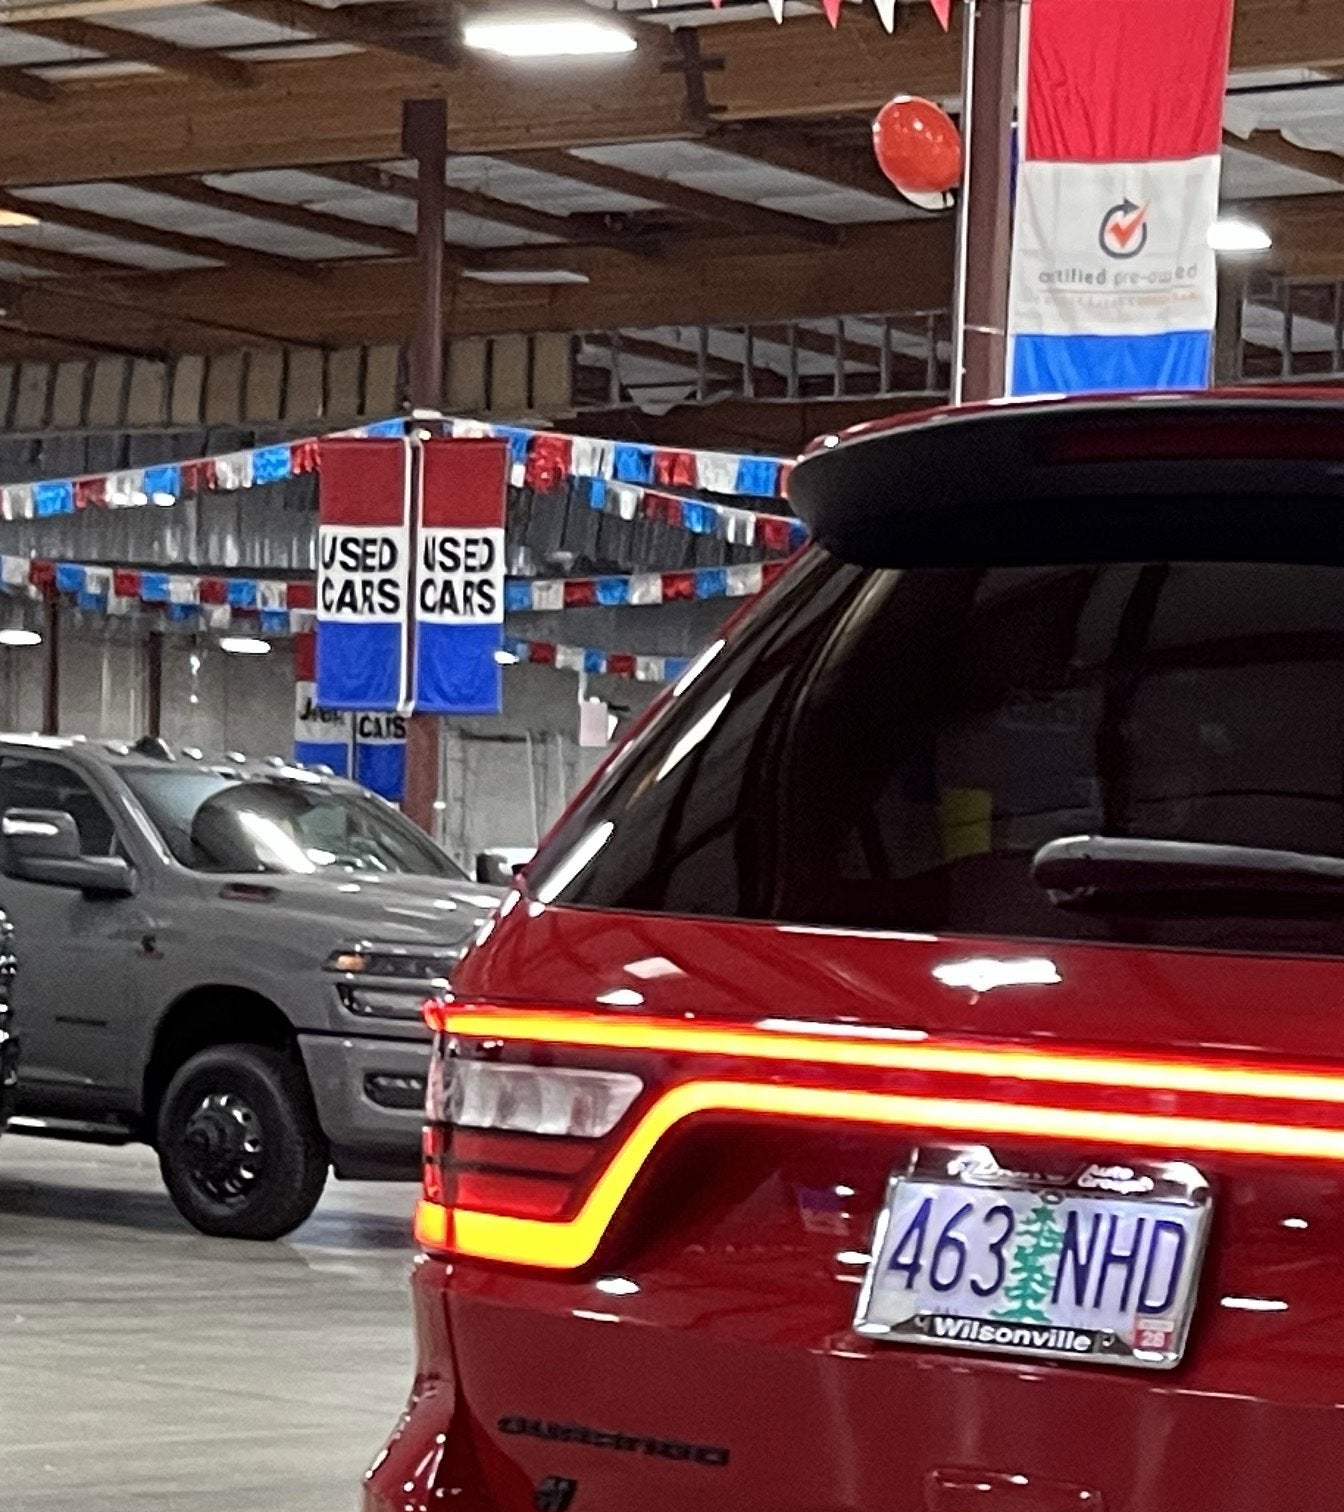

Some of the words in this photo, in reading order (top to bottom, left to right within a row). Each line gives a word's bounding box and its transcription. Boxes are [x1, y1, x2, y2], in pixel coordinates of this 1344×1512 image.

[321, 534, 399, 573] USED
[422, 535, 496, 574] USED
[321, 576, 401, 615] CARS
[420, 577, 496, 616] CARS
[889, 1197, 1016, 1298] 463
[1050, 1209, 1187, 1315] NHD
[933, 1318, 1092, 1351] Wilsonville
